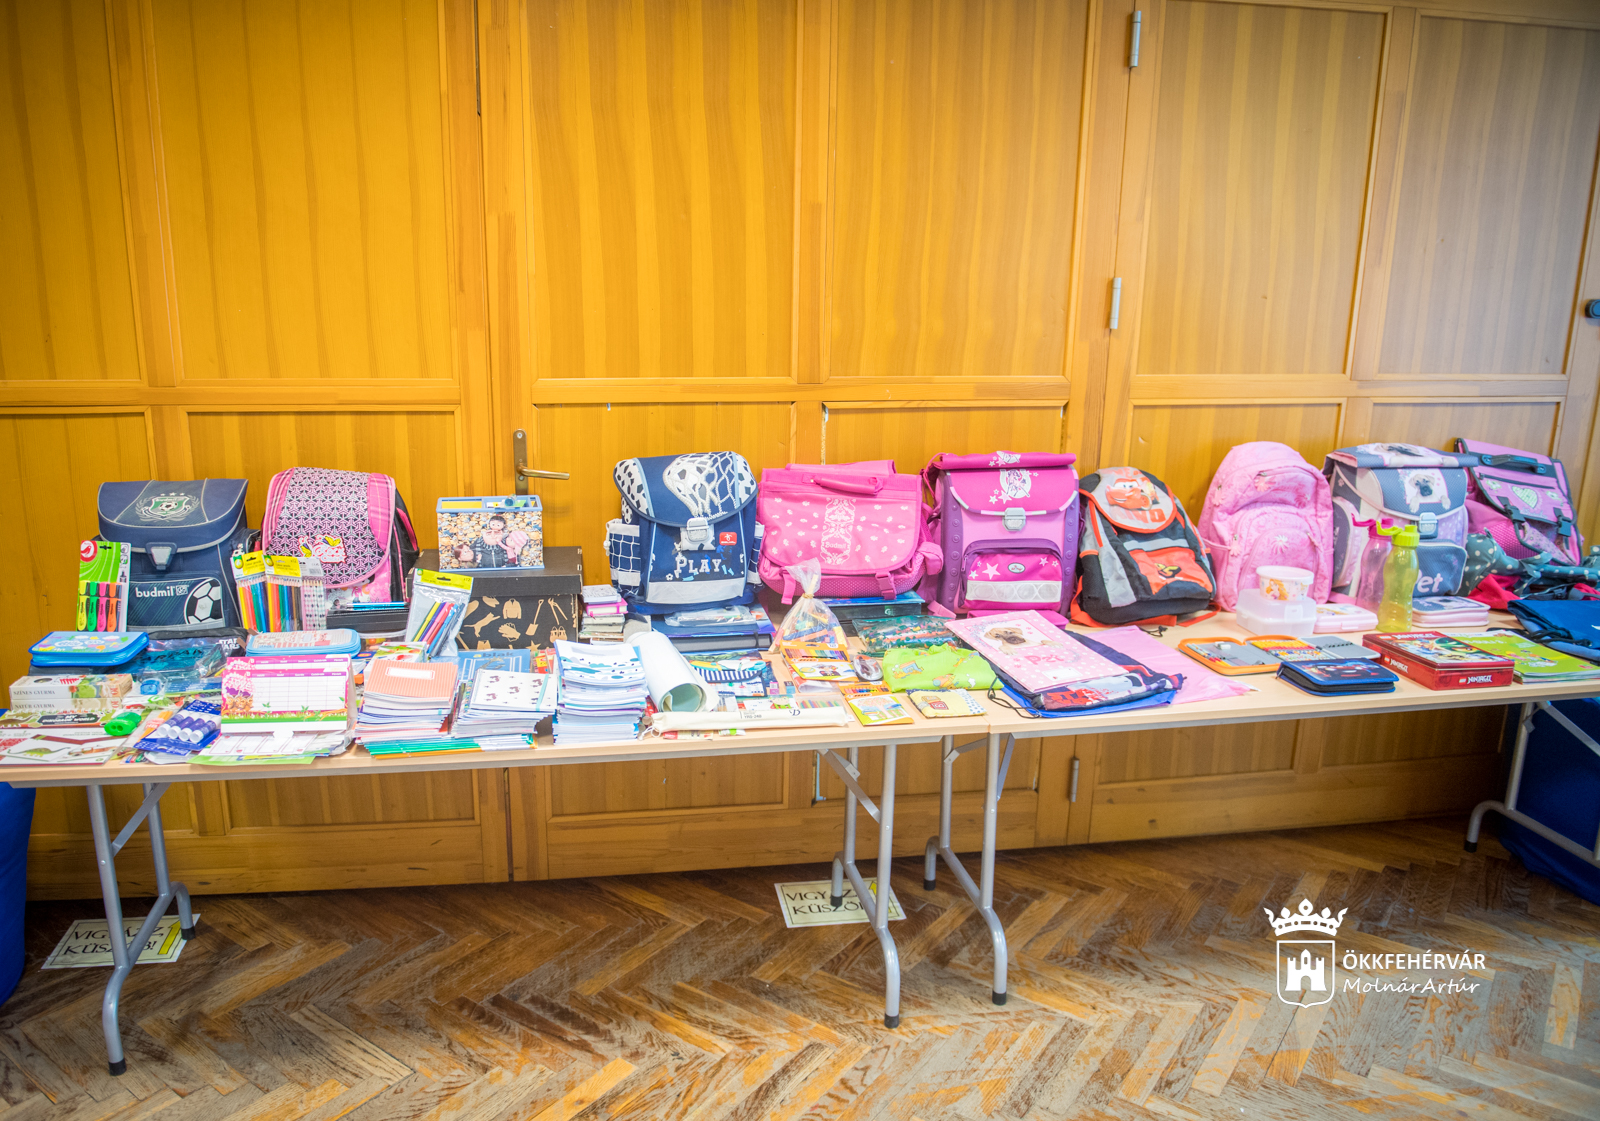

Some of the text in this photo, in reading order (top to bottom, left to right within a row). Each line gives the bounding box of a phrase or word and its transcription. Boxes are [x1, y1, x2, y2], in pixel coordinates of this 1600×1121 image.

[674, 555, 722, 577] PLAY
[135, 585, 174, 598] budmil
[1467, 675, 1493, 685] NINJAGO
[786, 889, 858, 901] VIGYZ
